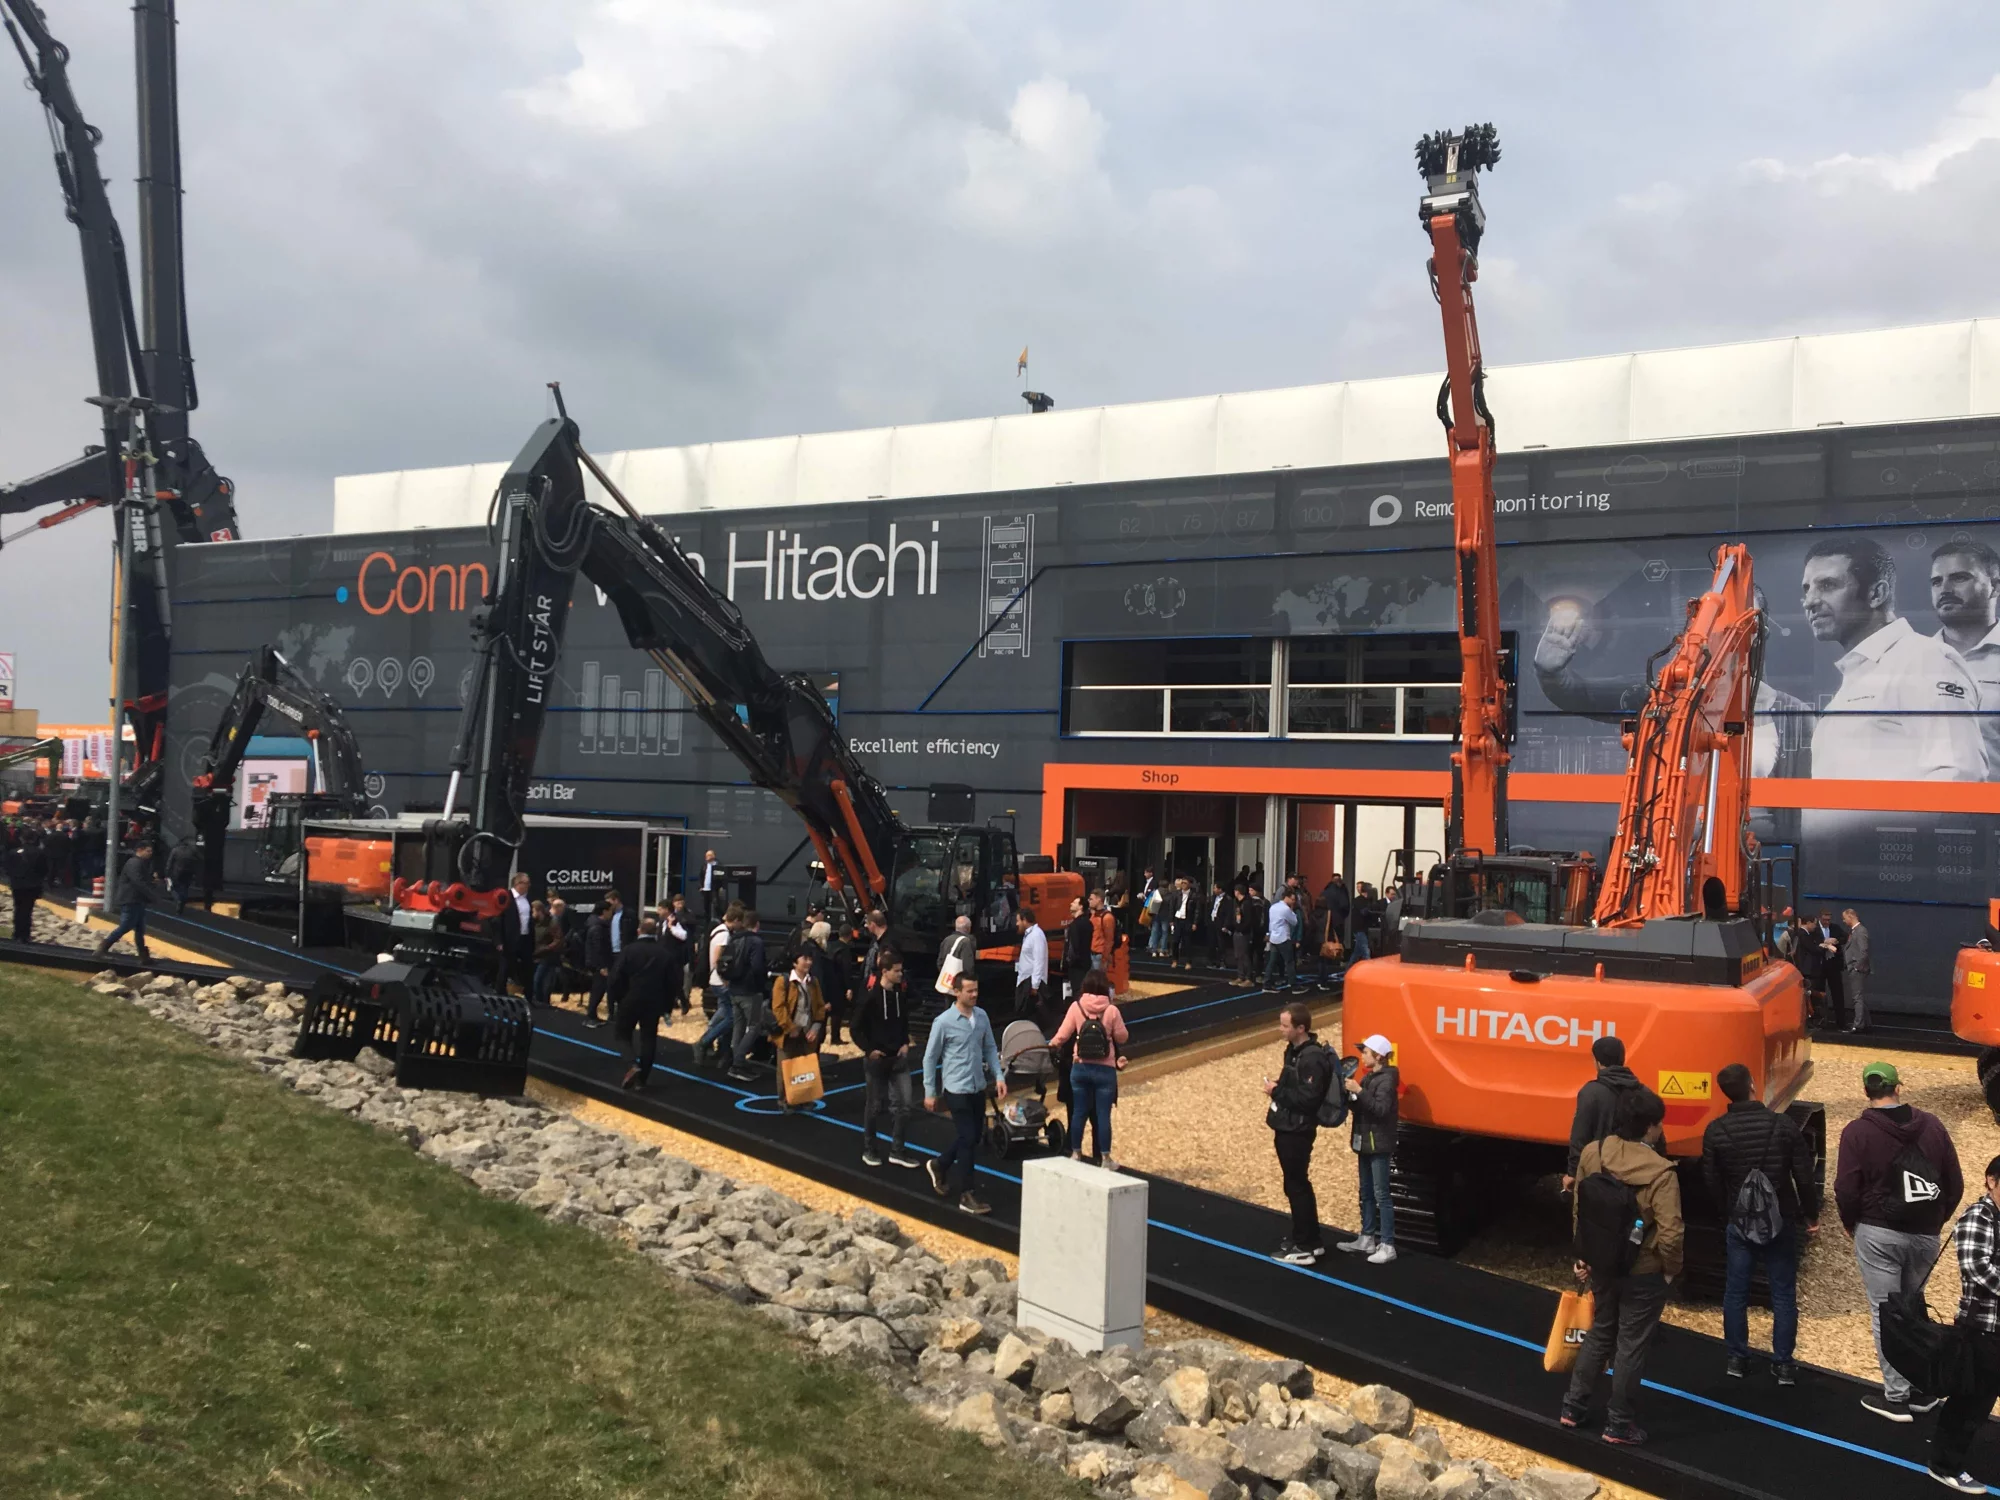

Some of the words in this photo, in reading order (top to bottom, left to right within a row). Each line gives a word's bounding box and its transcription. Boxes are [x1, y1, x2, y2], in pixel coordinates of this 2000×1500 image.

[1415, 500, 1455, 518] Remo
[1494, 491, 1611, 513] monitoring
[1182, 513, 1202, 531] 75
[1236, 509, 1260, 527] 87
[1302, 506, 1333, 523] 100
[1119, 517, 1142, 534] 62
[357, 551, 490, 616] Conn
[727, 520, 940, 602] Hitachi
[533, 594, 552, 653] STAR
[527, 657, 546, 704] LIFT
[850, 738, 919, 753] Excellent
[926, 738, 1000, 759] efficiency
[1142, 769, 1179, 786] Shop
[553, 783, 576, 800] Bar
[546, 869, 614, 884] COREUM
[1436, 1006, 1616, 1047] HITACHI
[1565, 1329, 1587, 1343] JC
